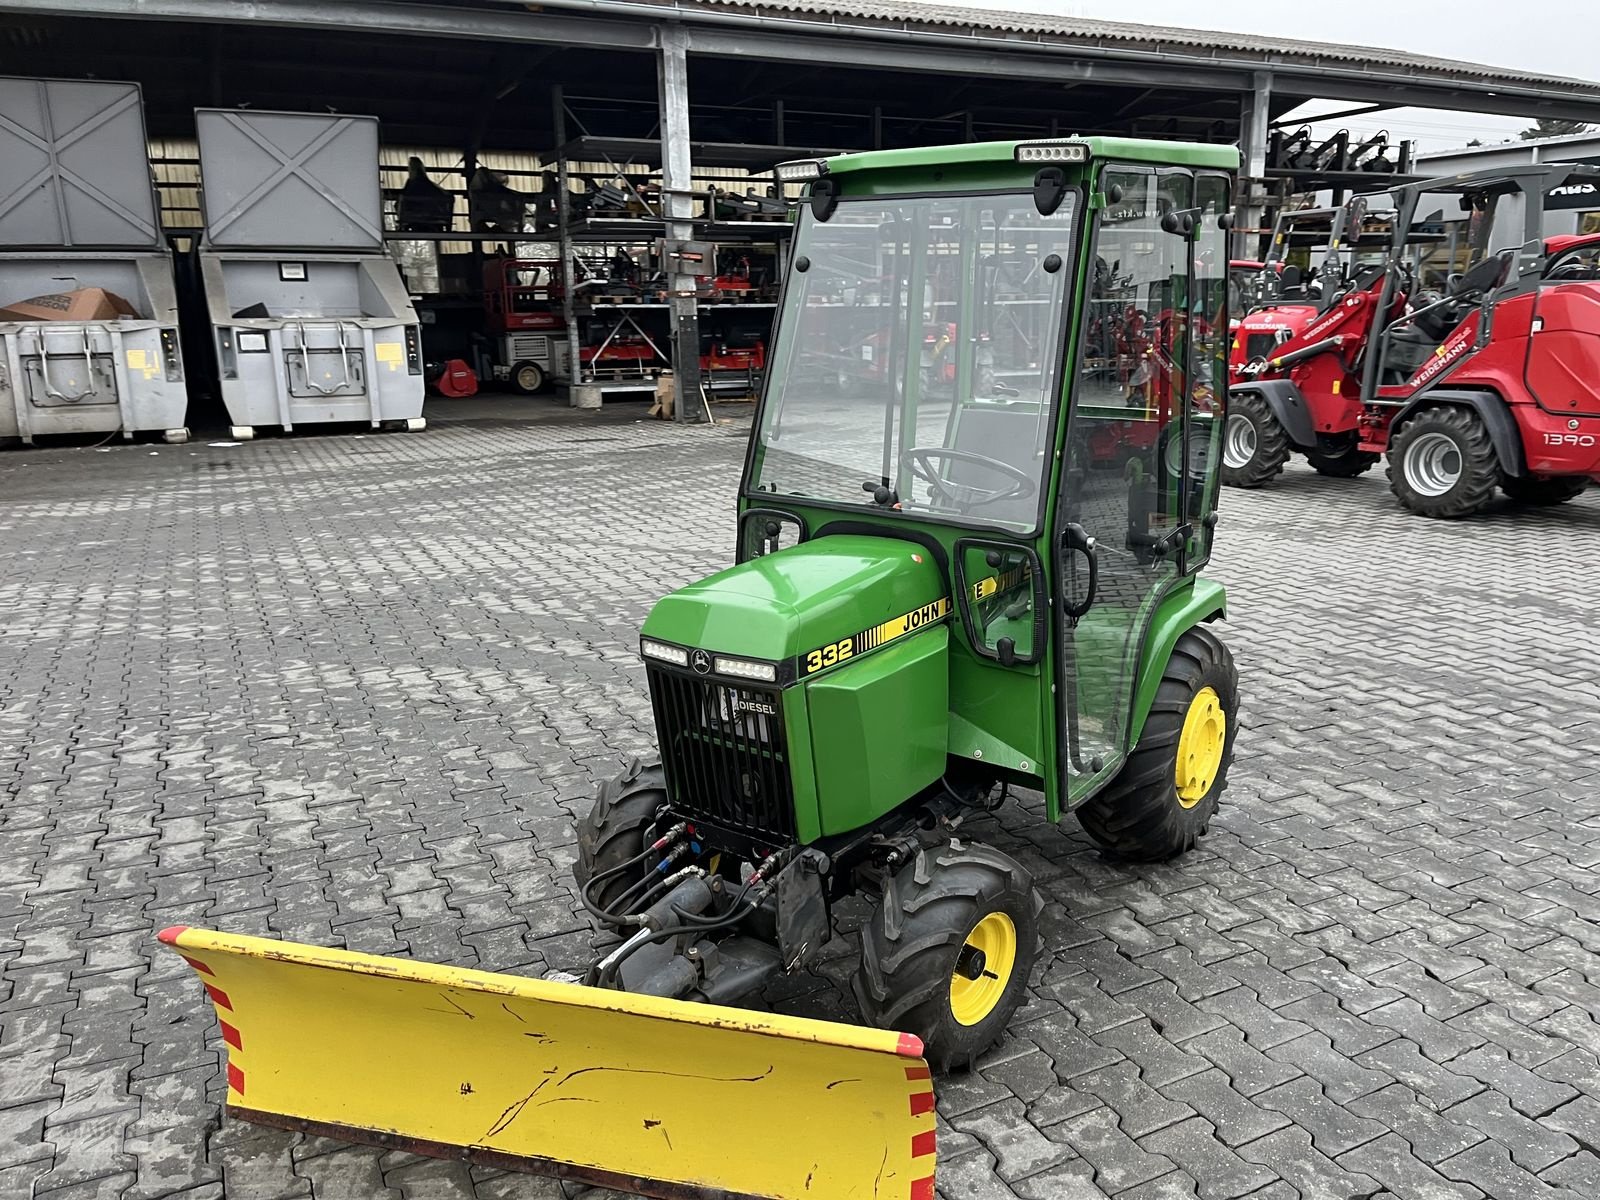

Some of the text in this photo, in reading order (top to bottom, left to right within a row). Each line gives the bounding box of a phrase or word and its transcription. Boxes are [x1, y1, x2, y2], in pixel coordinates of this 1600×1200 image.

[1410, 340, 1468, 388] WEIDEMANN
[1543, 433, 1595, 447] 1390
[903, 601, 939, 632] JOHN
[806, 638, 853, 673] 332
[738, 700, 776, 715] DIESEL
